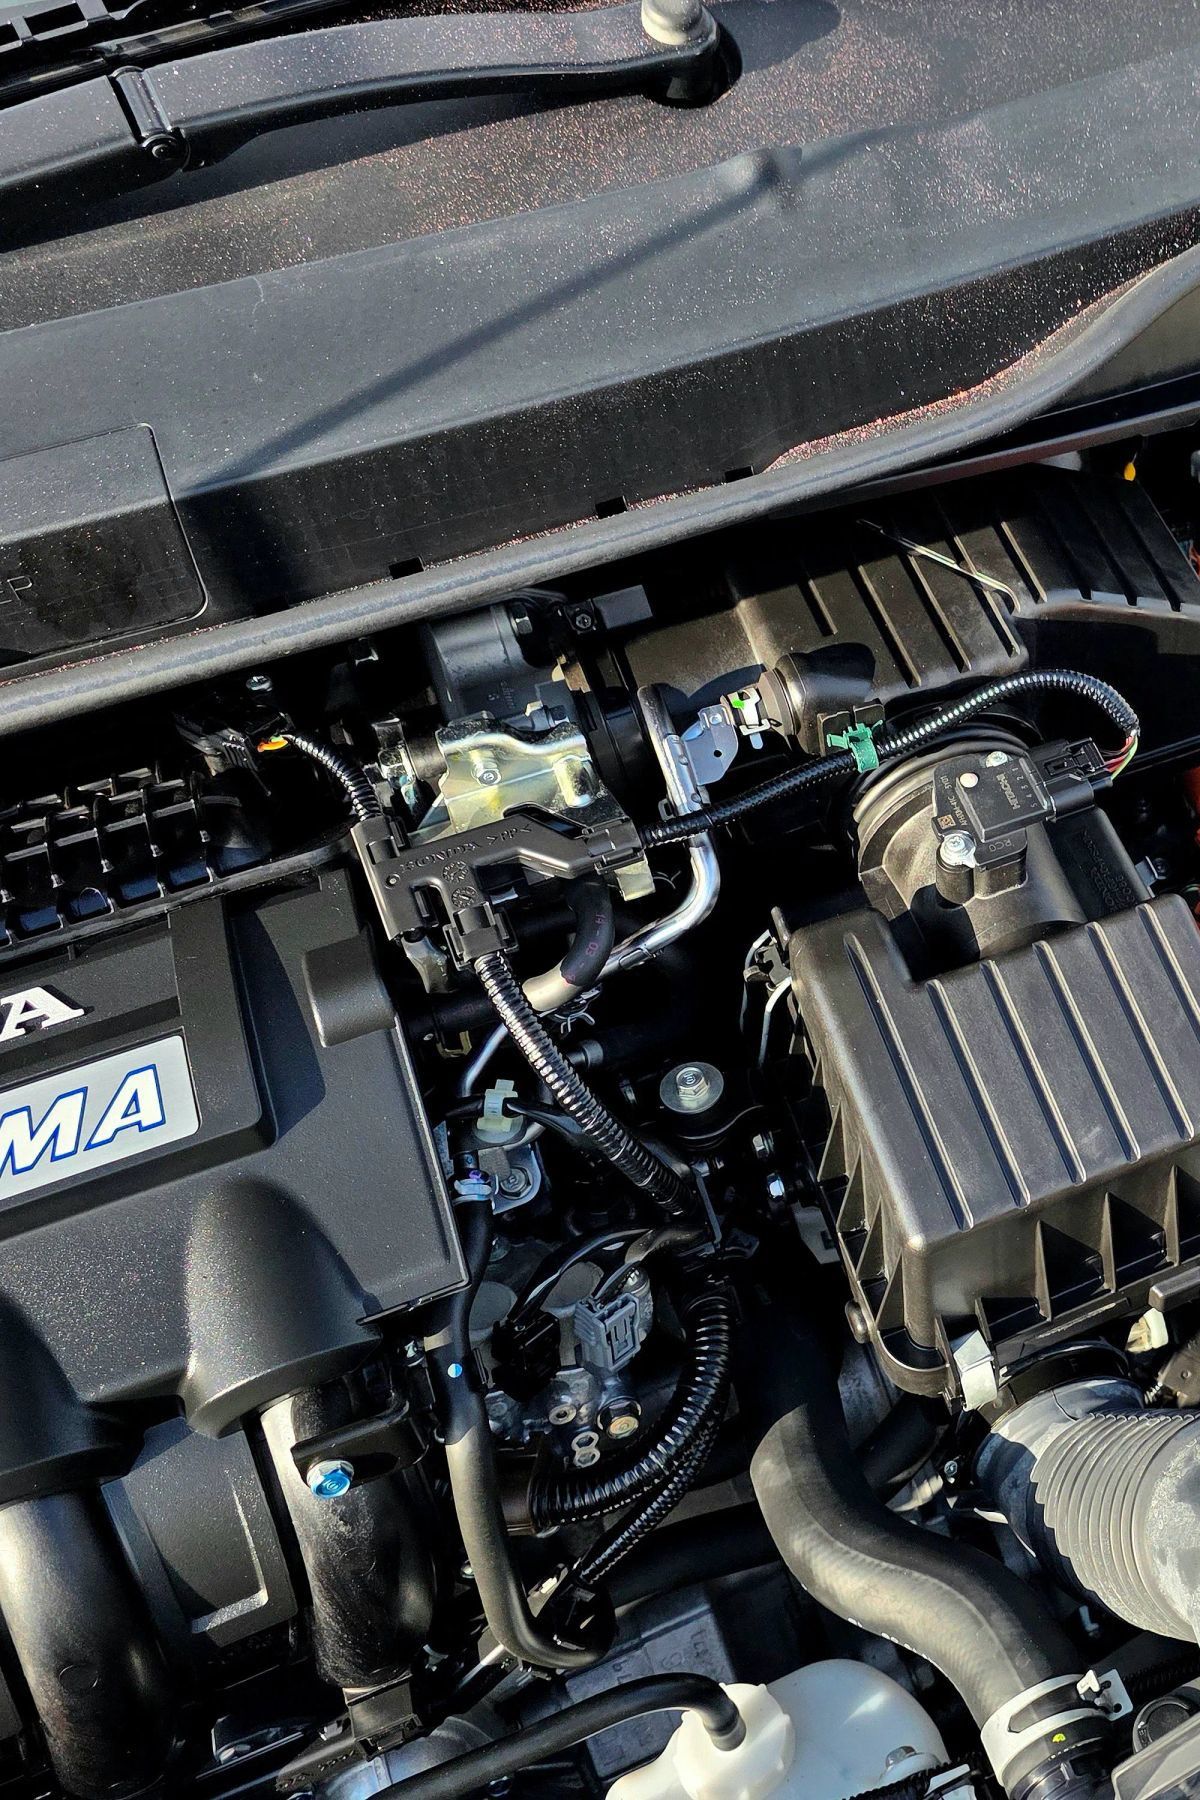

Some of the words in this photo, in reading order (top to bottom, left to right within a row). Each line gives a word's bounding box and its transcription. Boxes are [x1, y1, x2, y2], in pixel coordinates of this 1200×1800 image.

[996, 773, 1020, 809] HITACHI
[0, 985, 85, 1043] A
[0, 1063, 167, 1177] MA
